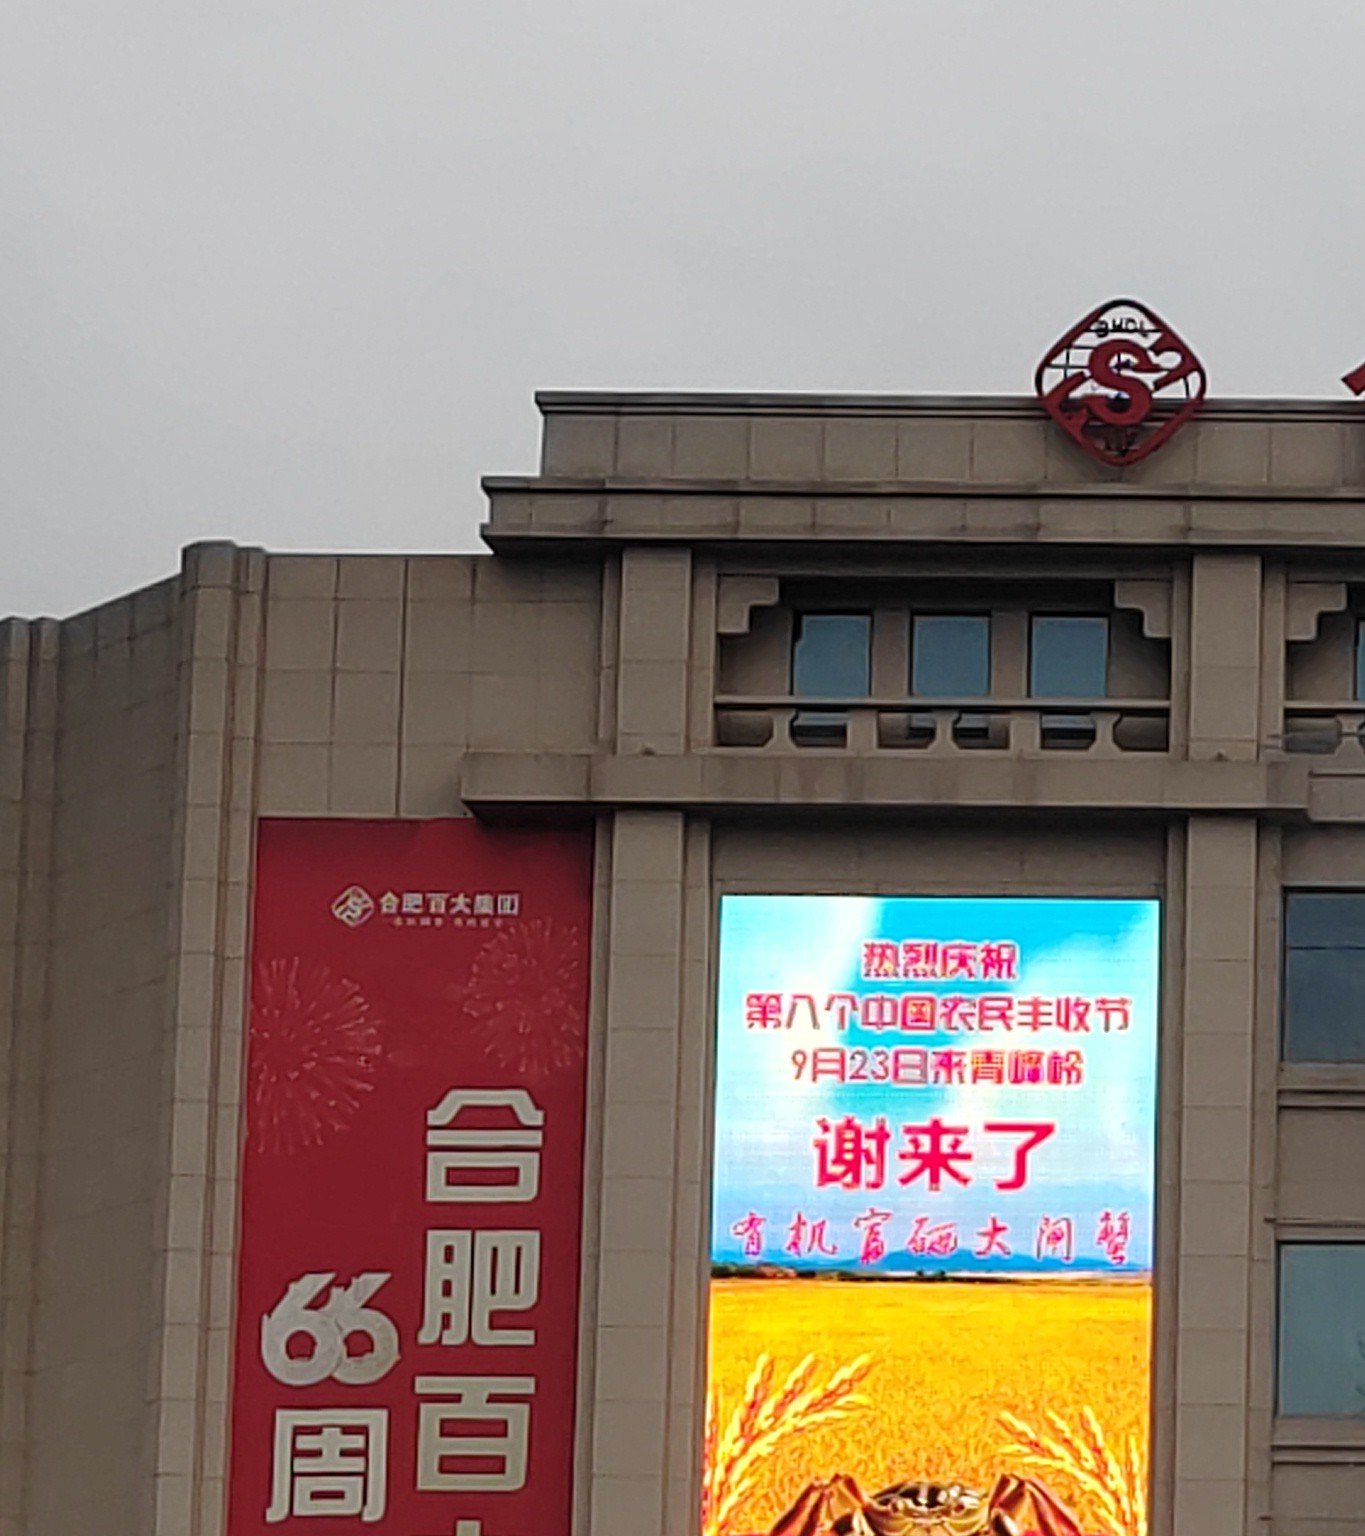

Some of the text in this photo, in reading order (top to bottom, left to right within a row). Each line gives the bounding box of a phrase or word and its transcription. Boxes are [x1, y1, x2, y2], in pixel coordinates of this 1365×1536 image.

[862, 943, 1018, 980] 热烈庆祝
[744, 991, 1132, 1034] 第八个中国农民丰收节
[813, 1114, 1056, 1192] 谢来了
